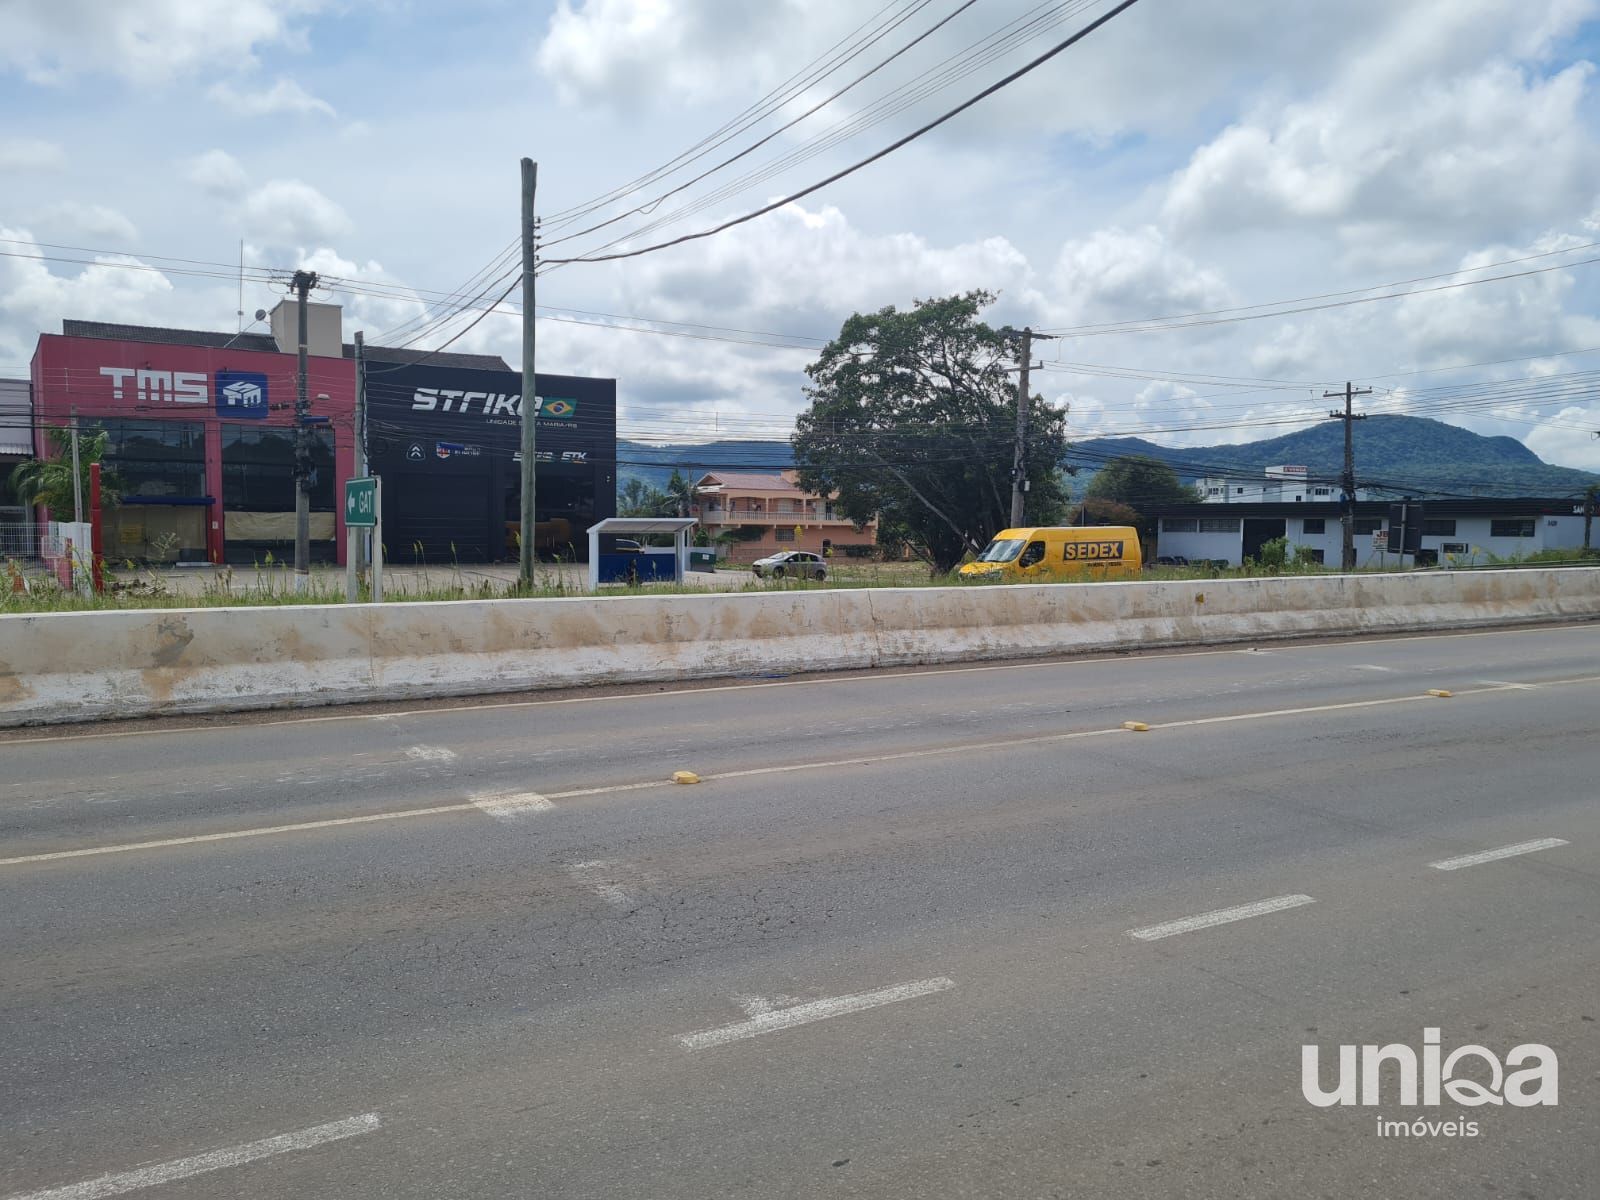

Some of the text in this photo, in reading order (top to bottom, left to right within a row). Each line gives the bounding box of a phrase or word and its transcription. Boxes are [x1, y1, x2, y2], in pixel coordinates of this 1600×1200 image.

[100, 366, 208, 403] TMS
[358, 490, 373, 514] GAT
[1066, 542, 1120, 559] SEDEX
